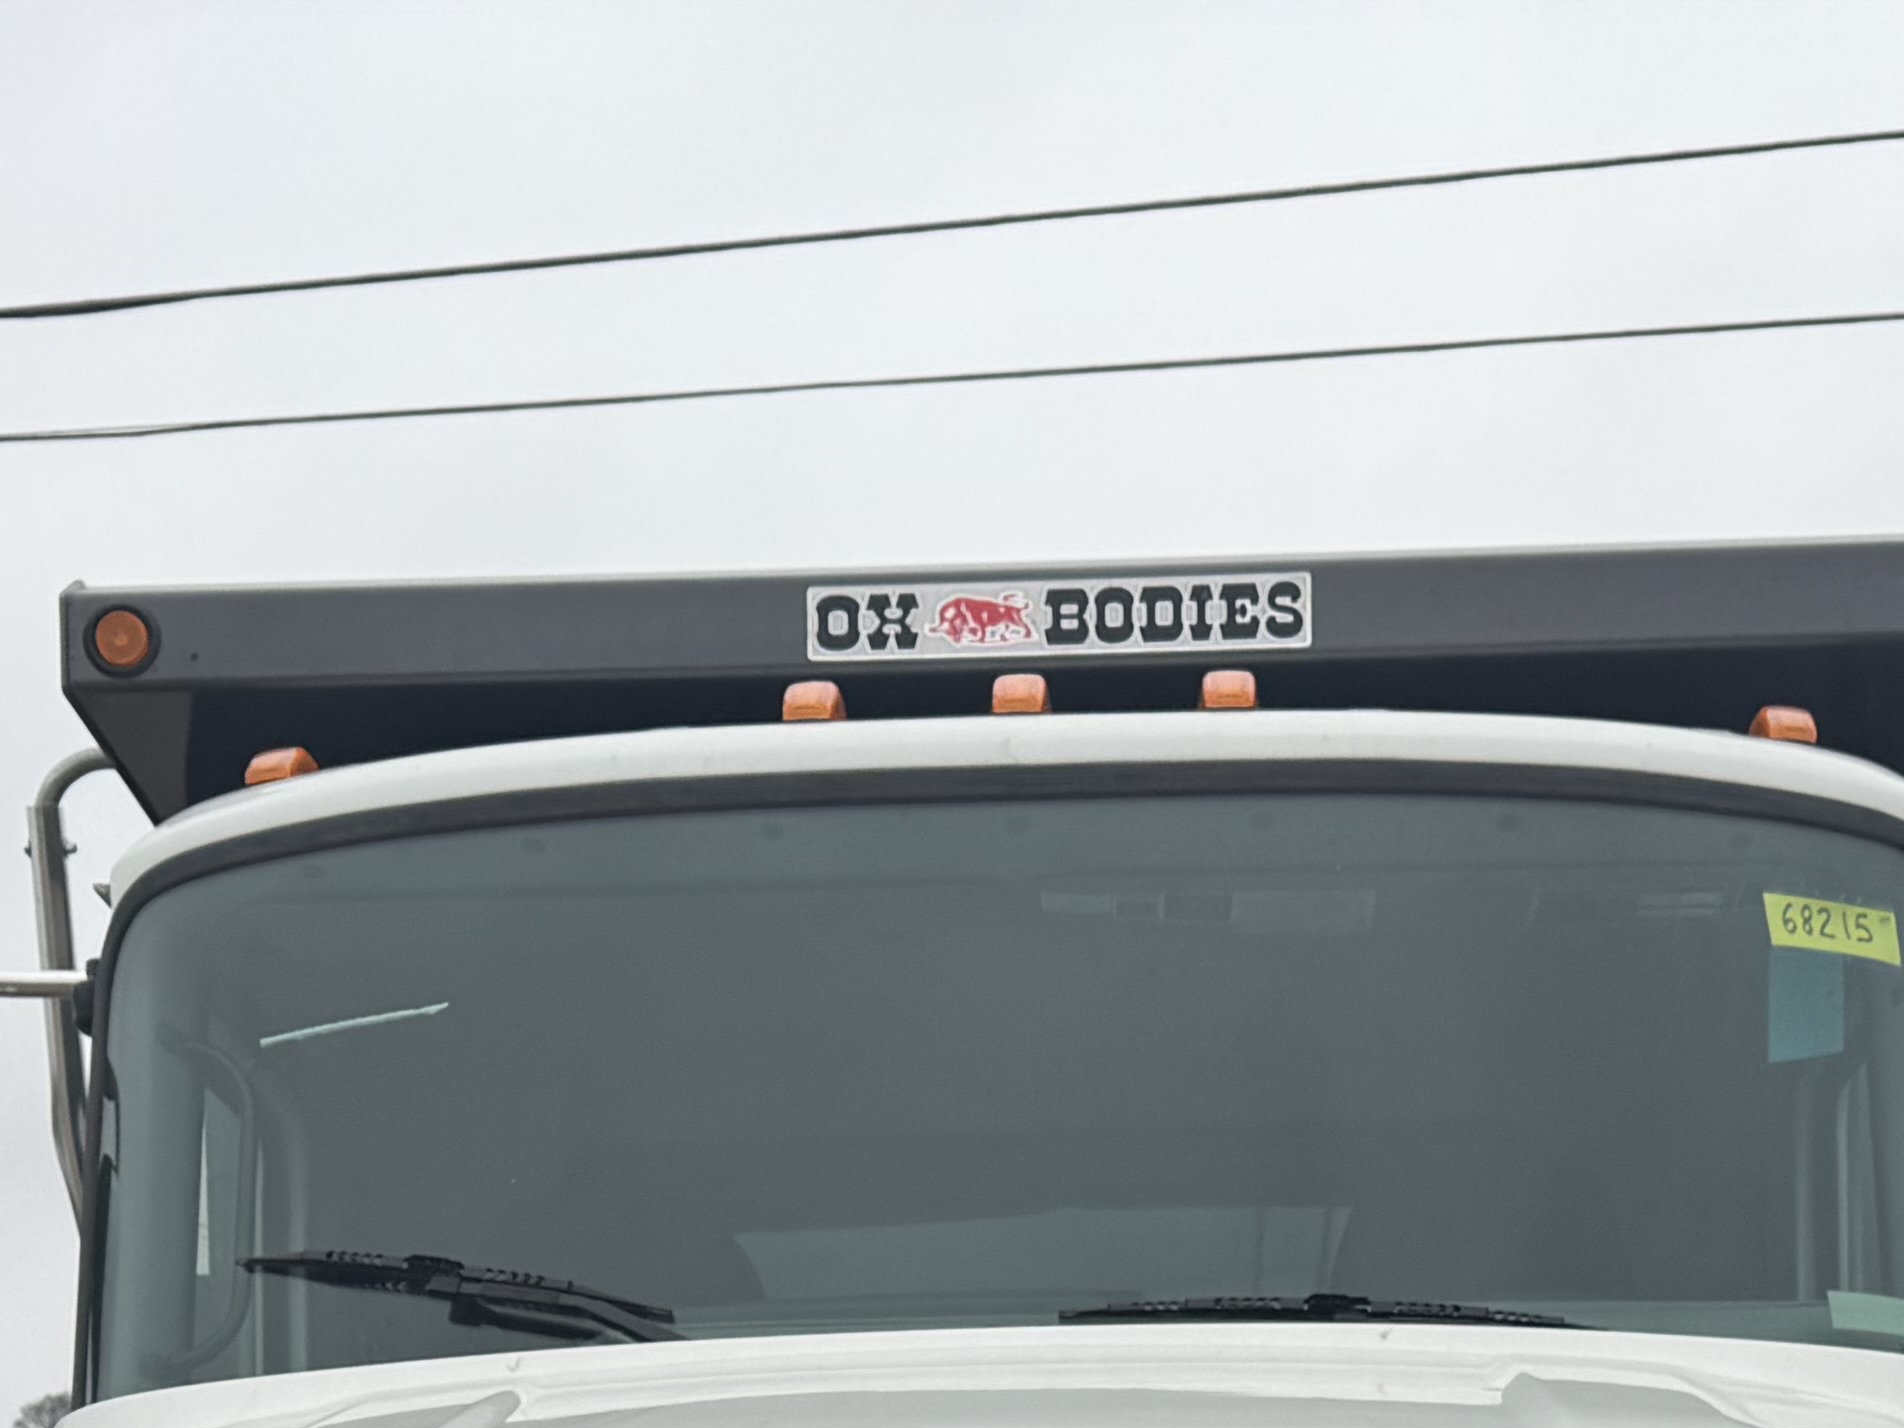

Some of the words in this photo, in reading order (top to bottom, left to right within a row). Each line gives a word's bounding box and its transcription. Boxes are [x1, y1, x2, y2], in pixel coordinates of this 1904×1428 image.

[817, 594, 920, 650] OX
[1045, 582, 1304, 646] BODIES
[1782, 902, 1874, 943] 68215
